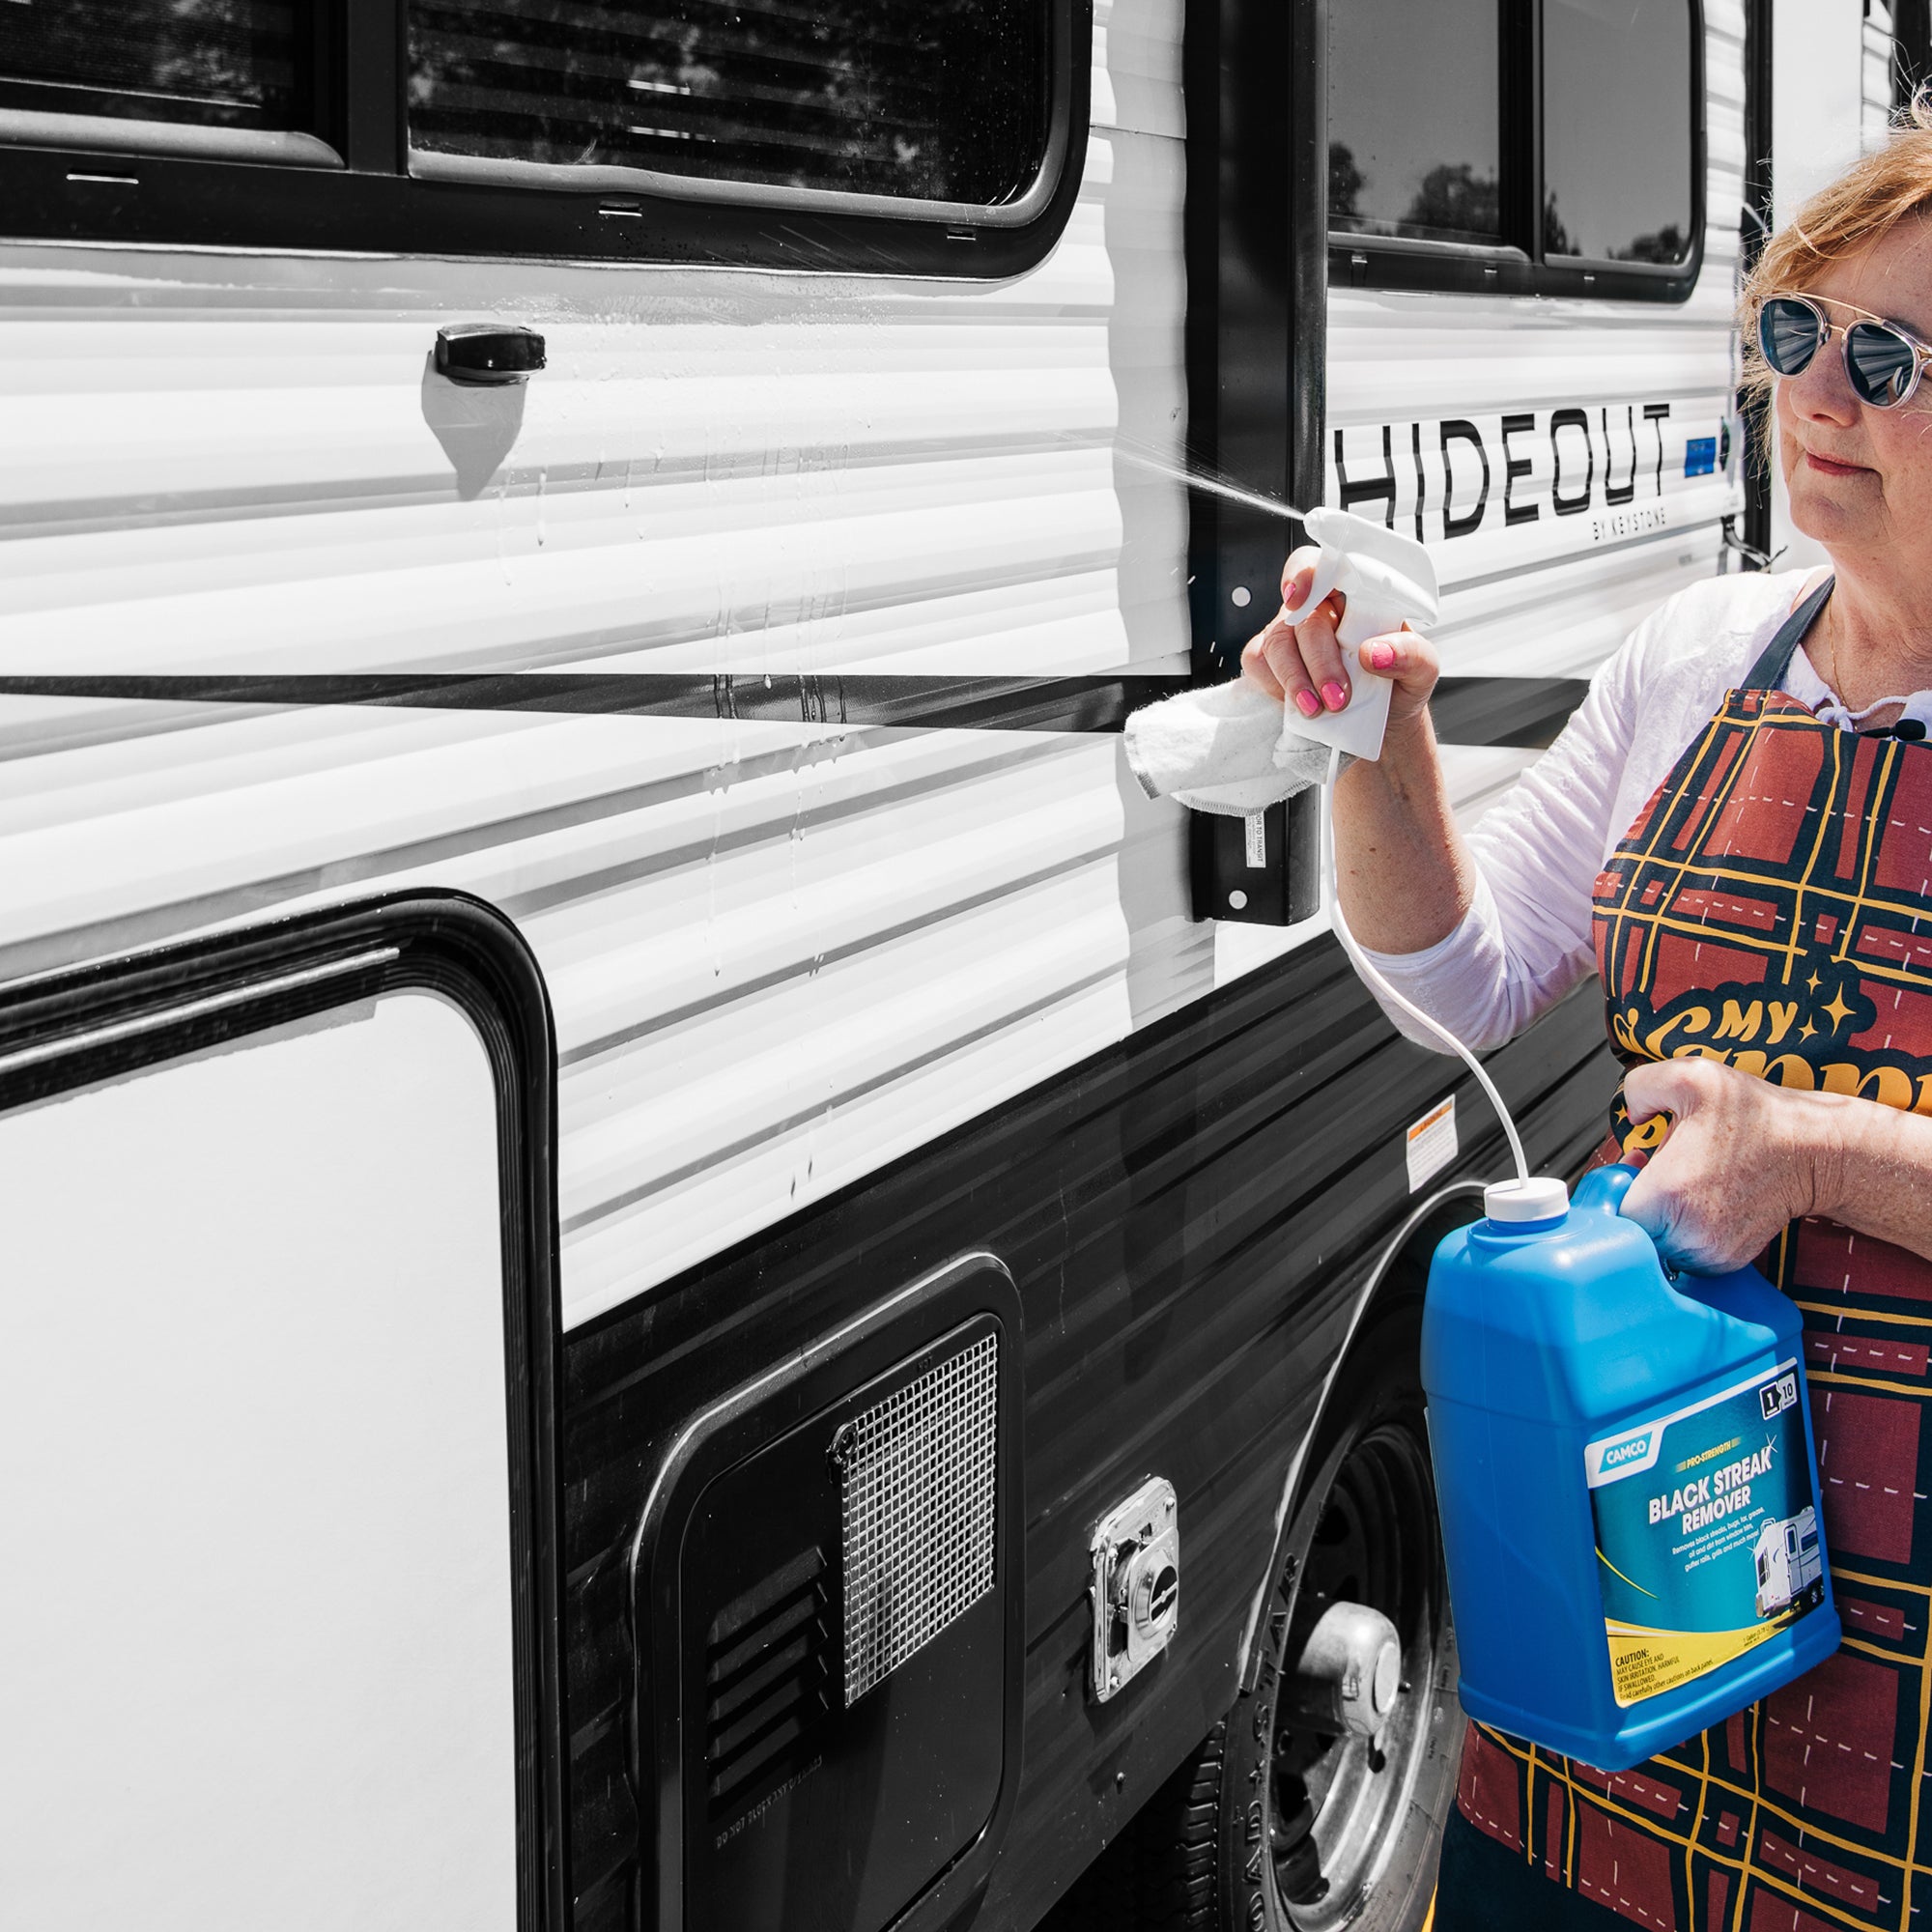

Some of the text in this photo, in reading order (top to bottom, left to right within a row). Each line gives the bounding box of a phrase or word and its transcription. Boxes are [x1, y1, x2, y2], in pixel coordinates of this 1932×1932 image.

[1334, 404, 1669, 544] HIDEOUT
[1593, 506, 1665, 540] BY KEYSTONE
[1712, 999, 1799, 1044] MY
[1767, 1392, 1774, 1407] 1
[1782, 1382, 1793, 1400] 10
[1605, 1439, 1647, 1465] CAMCO
[1686, 1440, 1732, 1468] PRO-STRENGTH
[1649, 1446, 1772, 1524] BLACK STREAK
[1682, 1485, 1751, 1535] REMOVER
[1695, 1533, 1710, 1545] black
[1695, 1545, 1706, 1555] and
[1725, 1528, 1744, 1541] window
[1722, 1543, 1733, 1552] and
[1615, 1648, 1650, 1667] CAUTION:
[1616, 1653, 1664, 1676] MAY CAUSE EYE AND
[1617, 1673, 1630, 1685] SKIN
[1633, 1684, 1653, 1697] carefully
[1653, 1680, 1666, 1690] other
[1666, 1672, 1685, 1685] cautions
[1685, 1668, 1691, 1677] on
[1690, 1663, 1701, 1674] back
[1242, 1800, 1264, 1932] OAD
